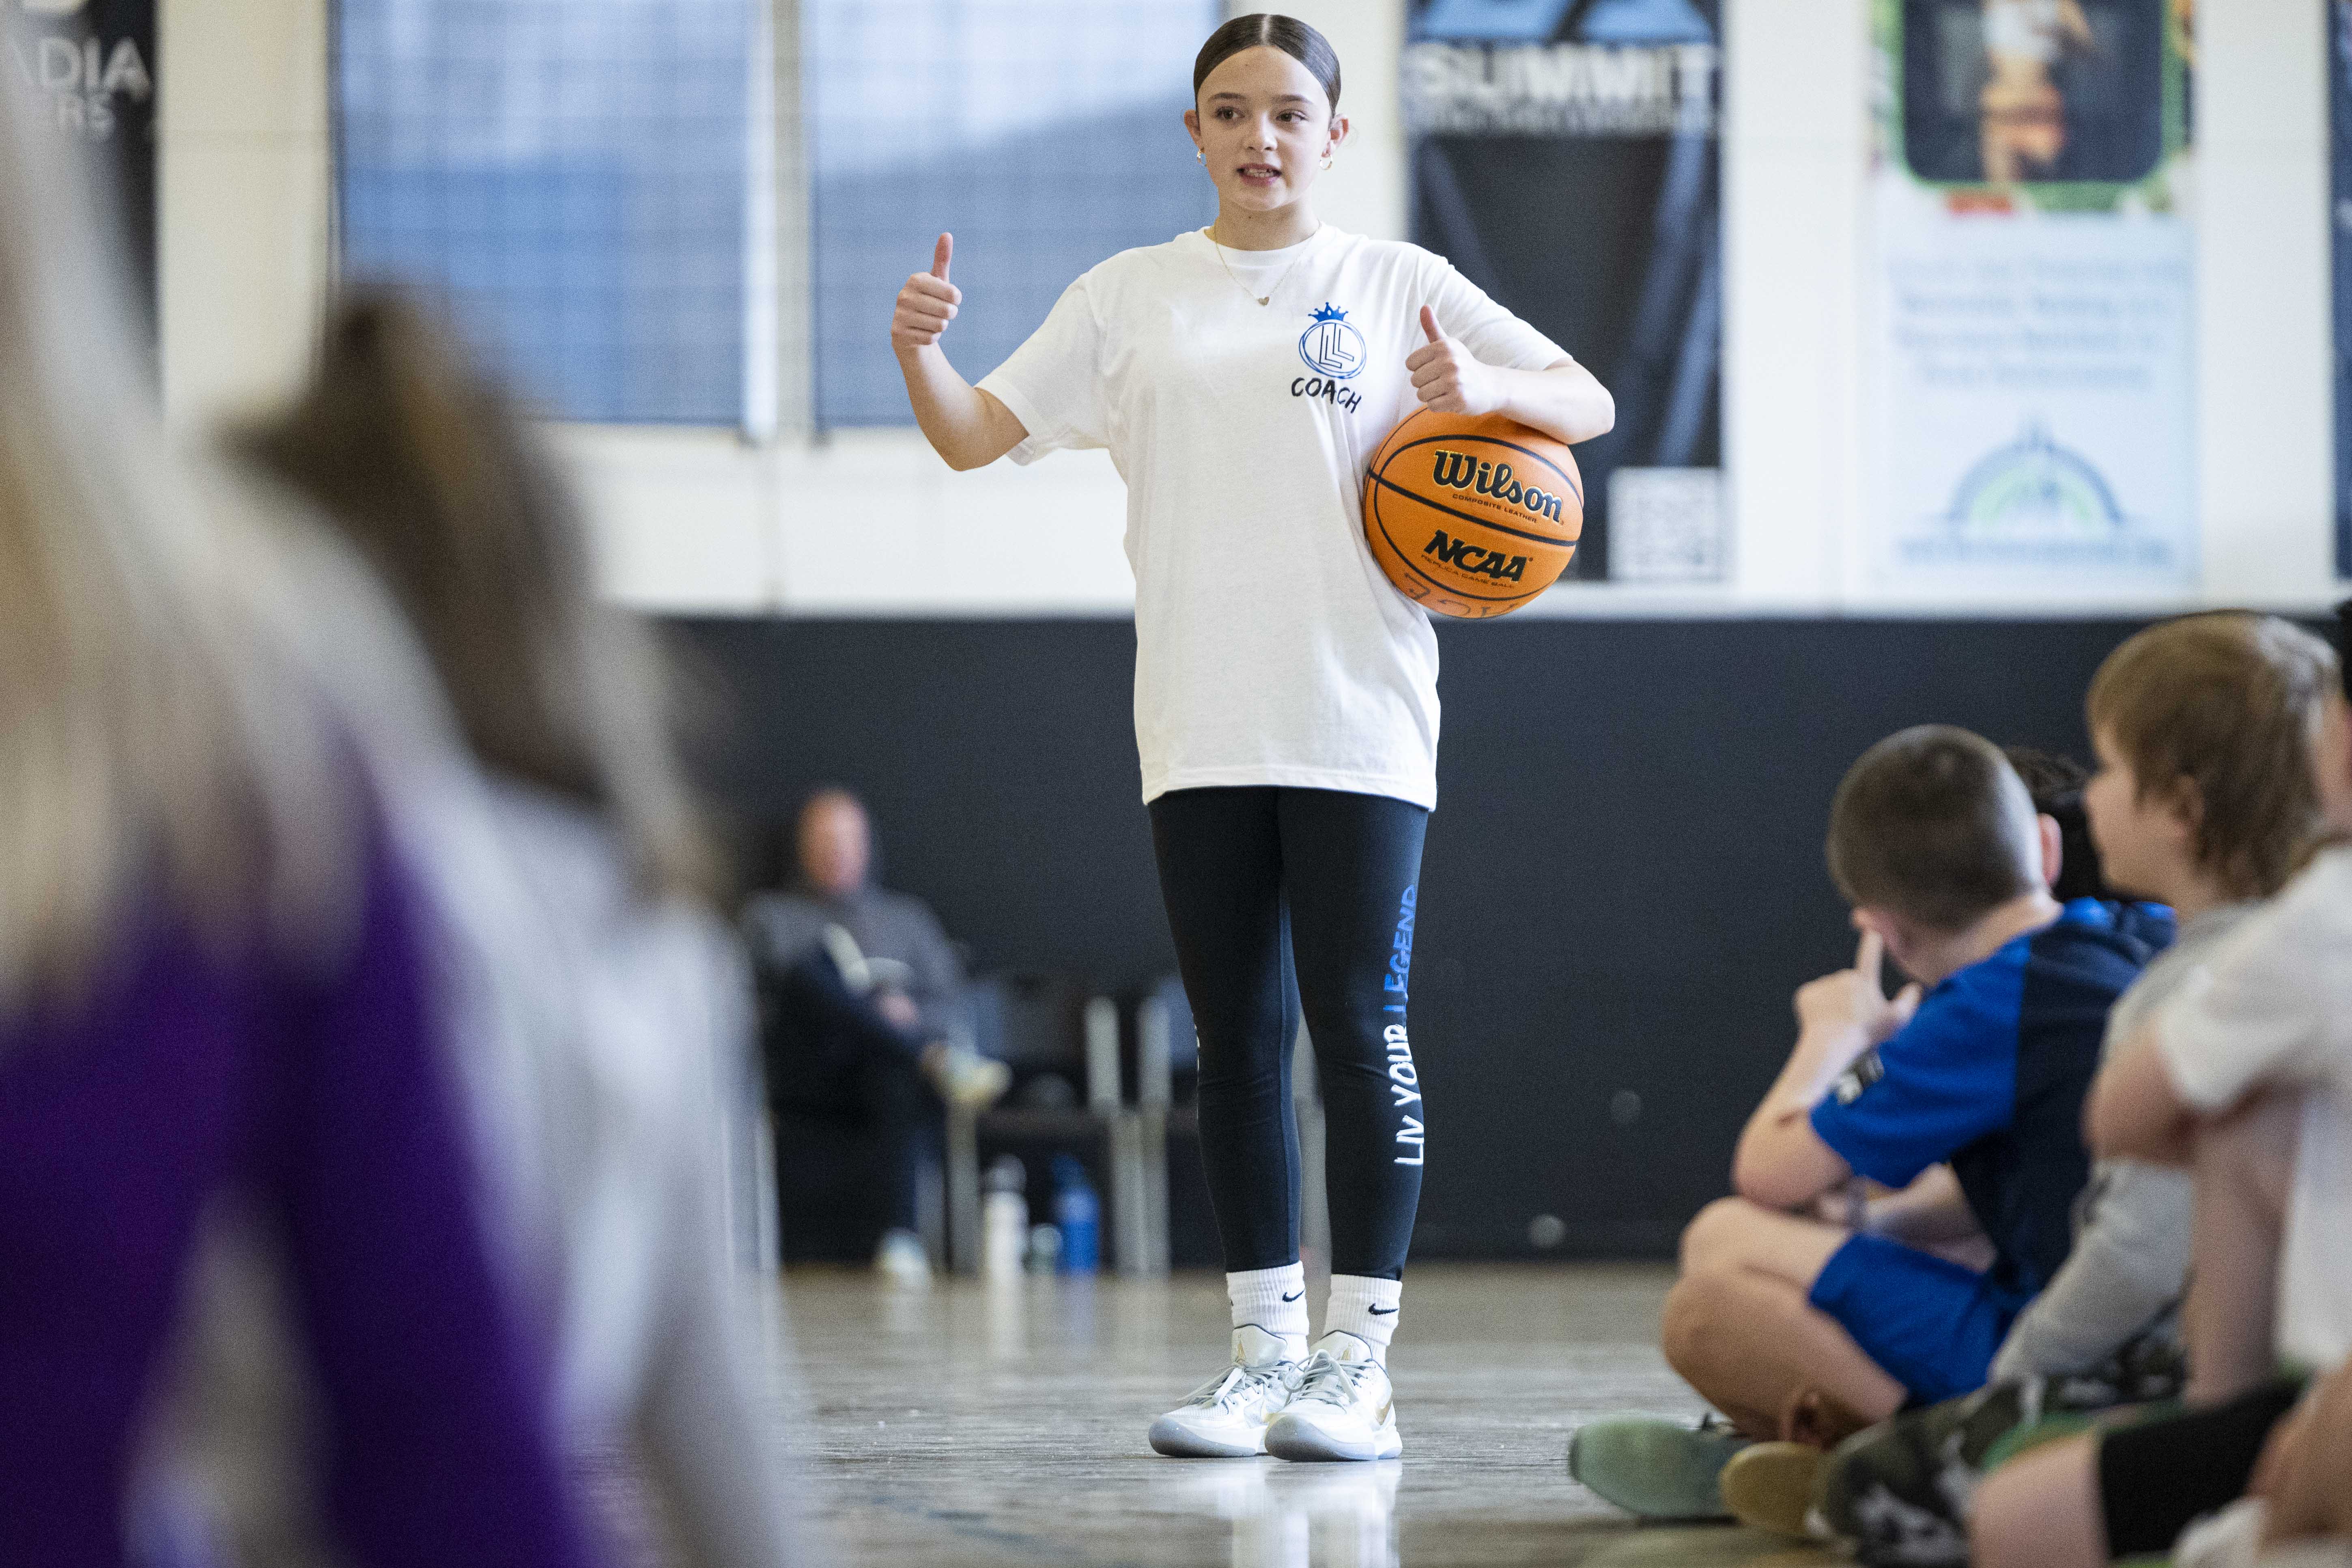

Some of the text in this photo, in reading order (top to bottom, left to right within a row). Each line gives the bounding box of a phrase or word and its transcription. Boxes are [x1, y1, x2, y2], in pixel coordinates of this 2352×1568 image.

[1404, 42, 1715, 106] SUMMIT
[1291, 377, 1362, 414] COACH
[1433, 449, 1563, 523] Wilson
[1453, 493, 1537, 523] COMPOSITE LEATHER
[1423, 529, 1528, 582] NCAA
[1461, 573, 1489, 585] GAME
[1383, 884, 1425, 1166] LIV YOUR LEGEND
